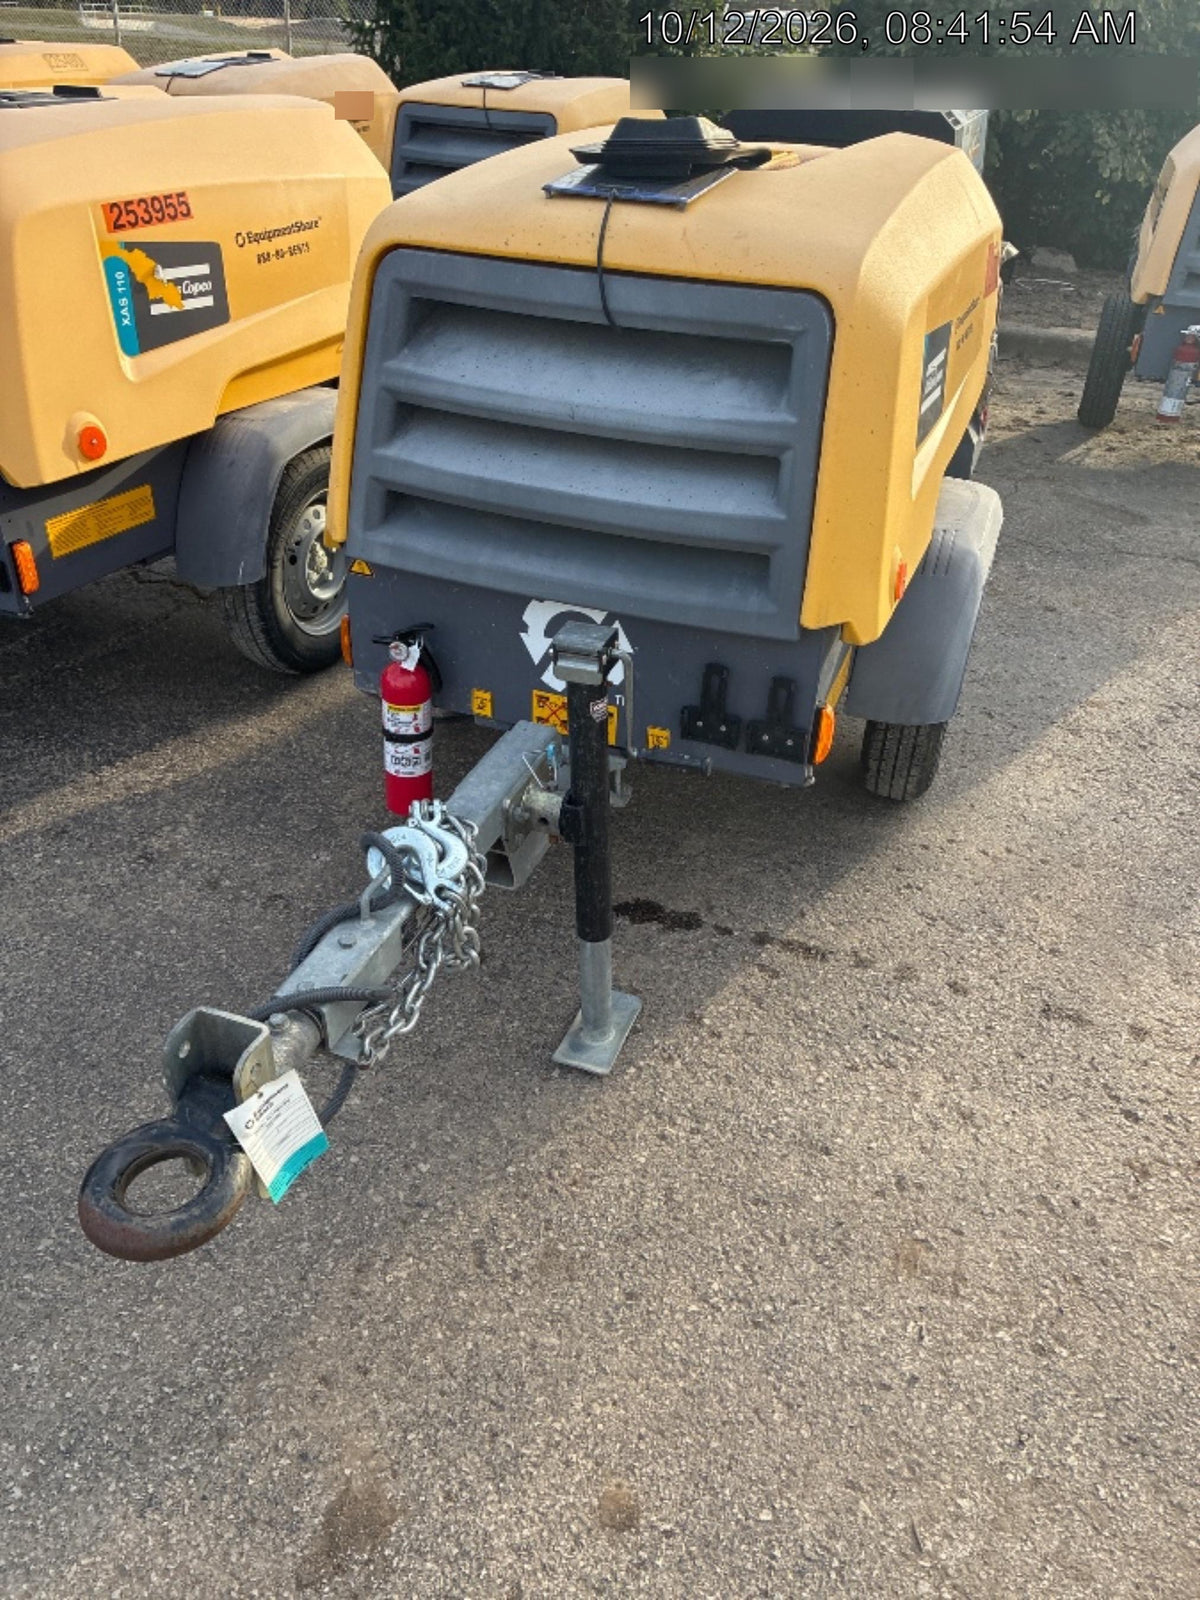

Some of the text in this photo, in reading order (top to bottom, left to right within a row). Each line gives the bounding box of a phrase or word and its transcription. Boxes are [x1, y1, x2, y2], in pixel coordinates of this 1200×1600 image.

[109, 191, 192, 231] 253955
[114, 271, 132, 326] XAS 110
[182, 280, 212, 296] Copco
